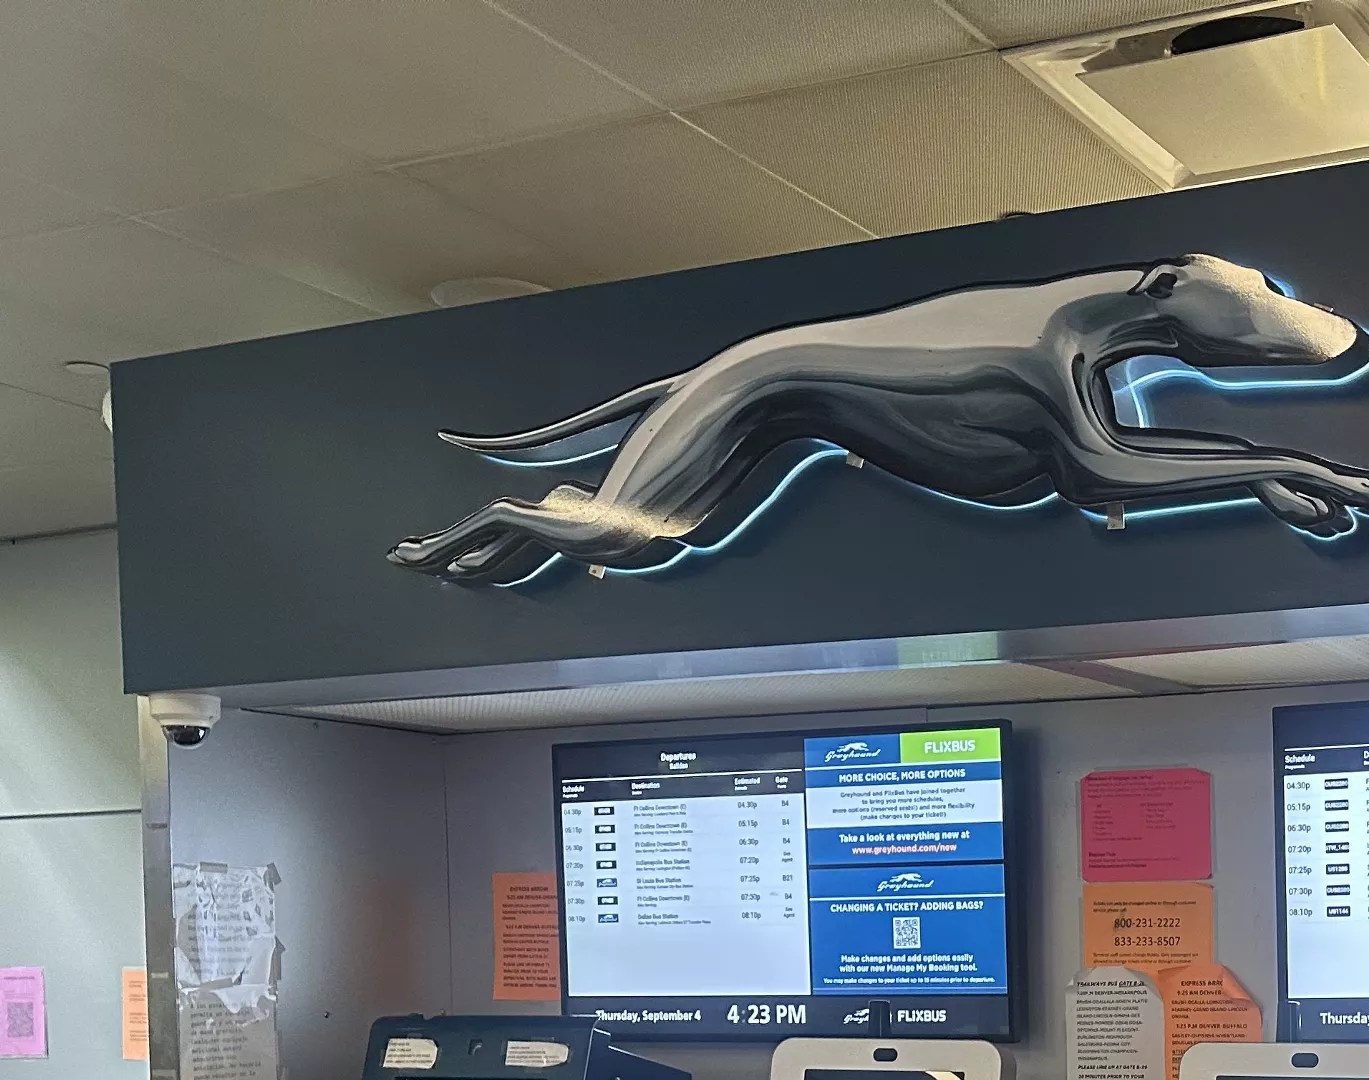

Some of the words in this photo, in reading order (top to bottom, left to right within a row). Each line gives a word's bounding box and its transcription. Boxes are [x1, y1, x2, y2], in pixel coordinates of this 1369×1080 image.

[1285, 754, 1315, 763] Schedule
[839, 774, 864, 783] MORE
[865, 772, 900, 782] CHOICE,
[901, 771, 926, 780] MORE
[927, 769, 966, 779] OPTIONS
[839, 834, 858, 843] Take
[867, 833, 885, 842] look
[886, 833, 895, 841] at
[896, 831, 940, 842] everything
[960, 830, 970, 839] at
[831, 903, 875, 912] CHANGING
[876, 903, 883, 911] A
[885, 902, 918, 911] TICKET?
[920, 902, 954, 911] ADDING
[956, 901, 983, 910] BAGS?
[1114, 918, 1181, 928] 800-231-2222
[1114, 936, 1181, 946] 833-233-8507
[642, 1010, 693, 1023] September
[694, 1011, 701, 1020] 4
[727, 1005, 770, 1024] 4:23
[776, 1005, 806, 1024] PM
